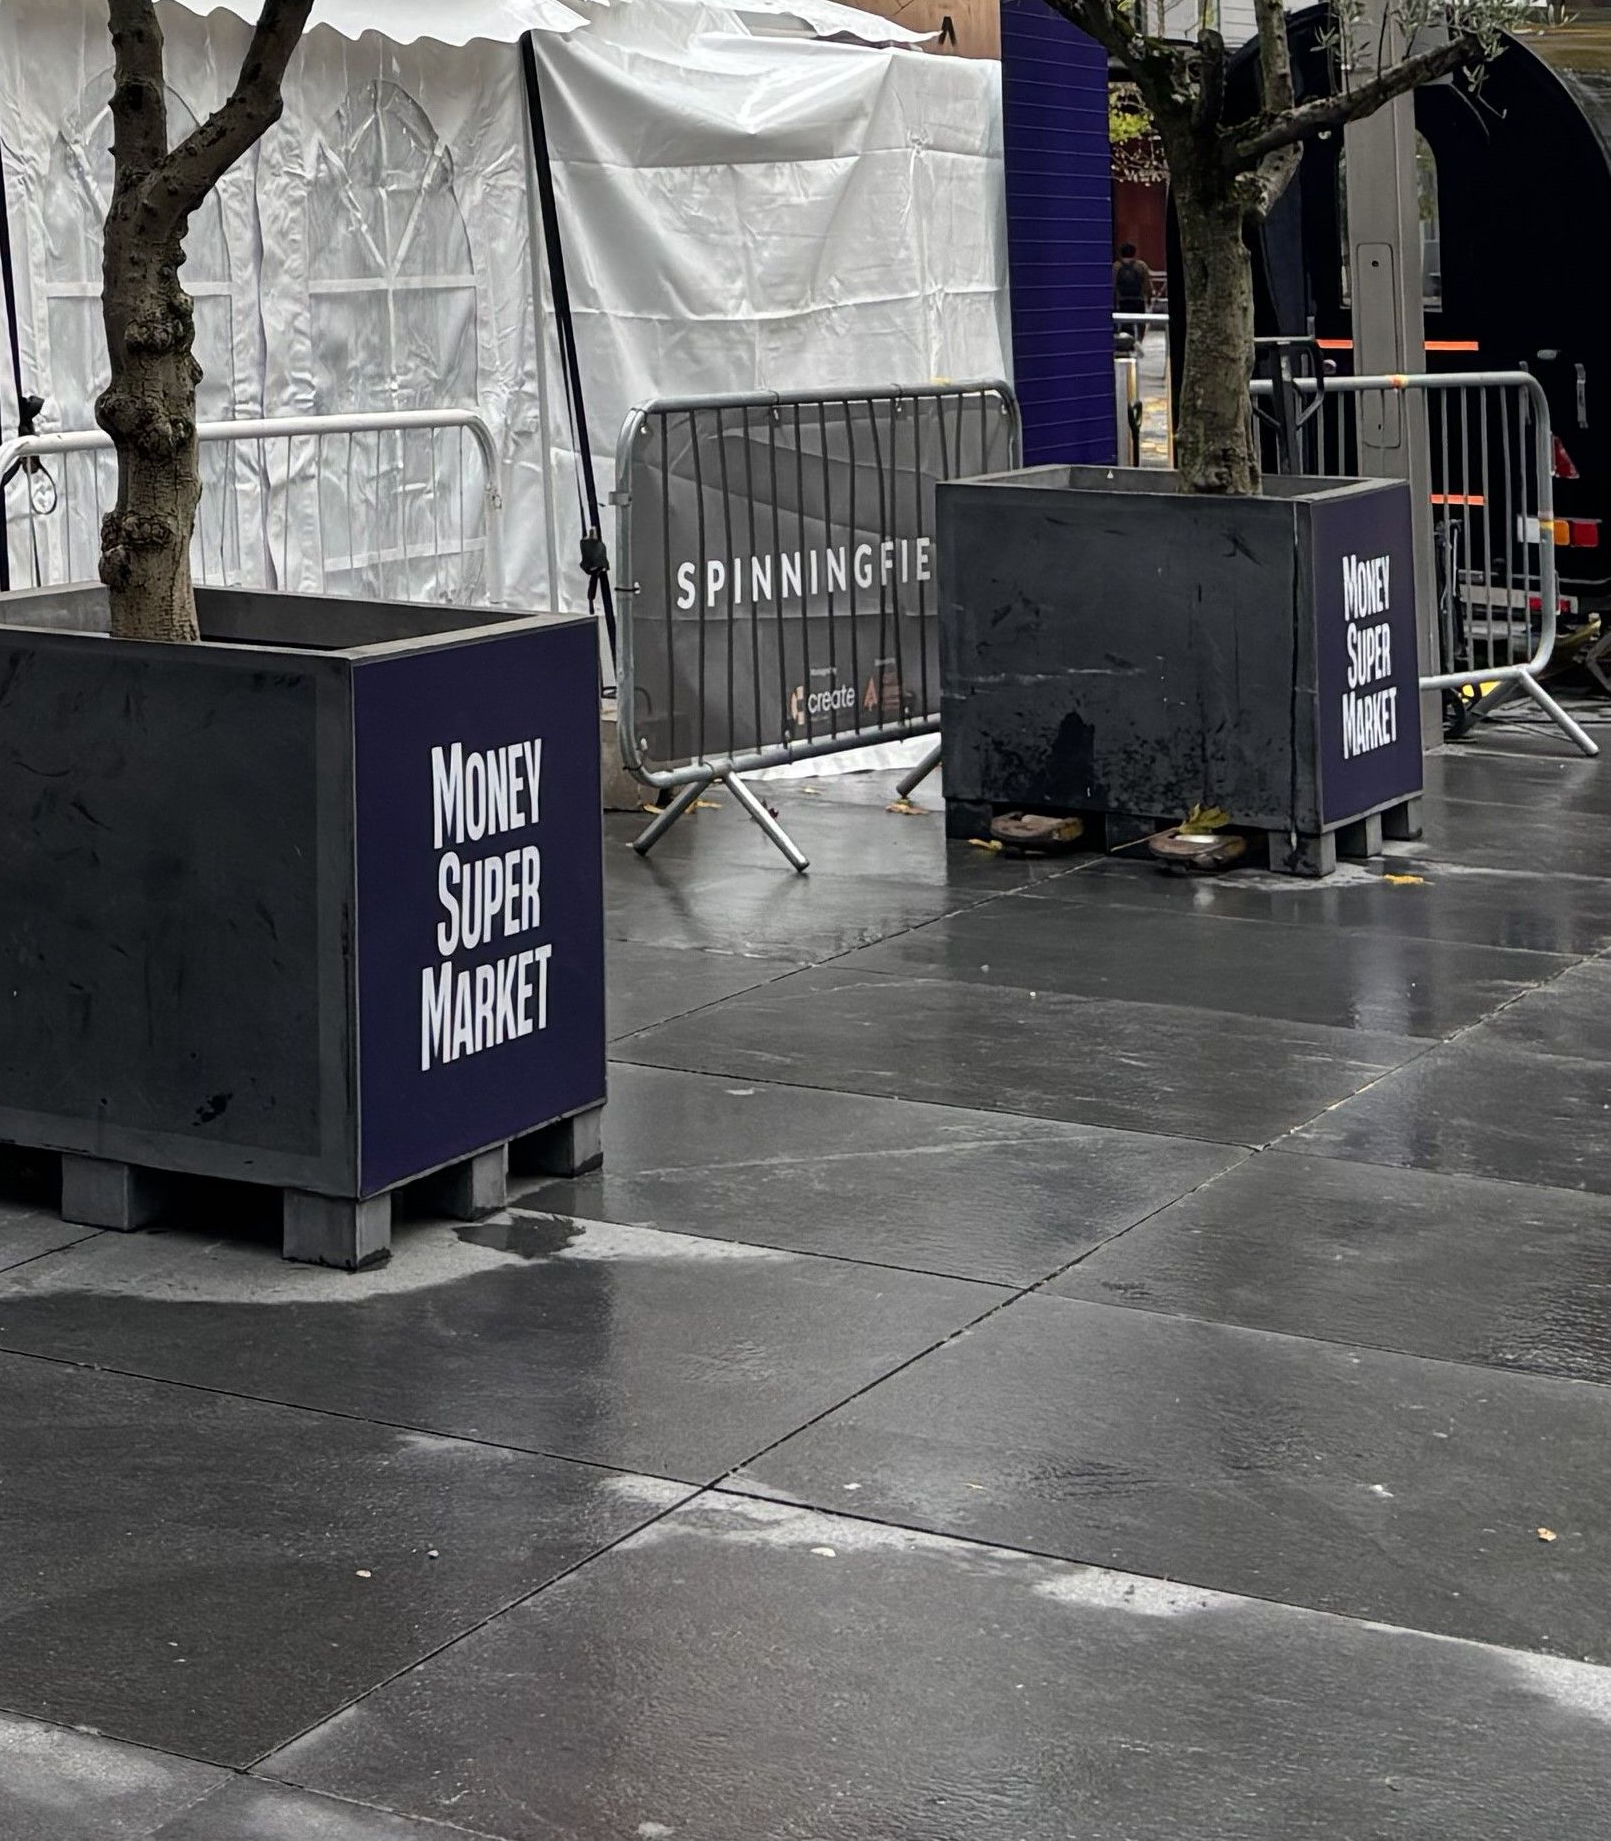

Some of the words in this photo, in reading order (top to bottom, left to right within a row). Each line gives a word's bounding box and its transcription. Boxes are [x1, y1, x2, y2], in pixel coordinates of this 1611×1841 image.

[676, 536, 932, 610] SPINNINGFIE
[1342, 554, 1390, 622] MONEY
[1346, 622, 1392, 689] SUPER
[807, 684, 856, 714] create
[1342, 686, 1397, 760] MARKET
[431, 737, 543, 850] MONEY
[437, 845, 542, 957] SUPER
[420, 944, 552, 1072] MARKET
